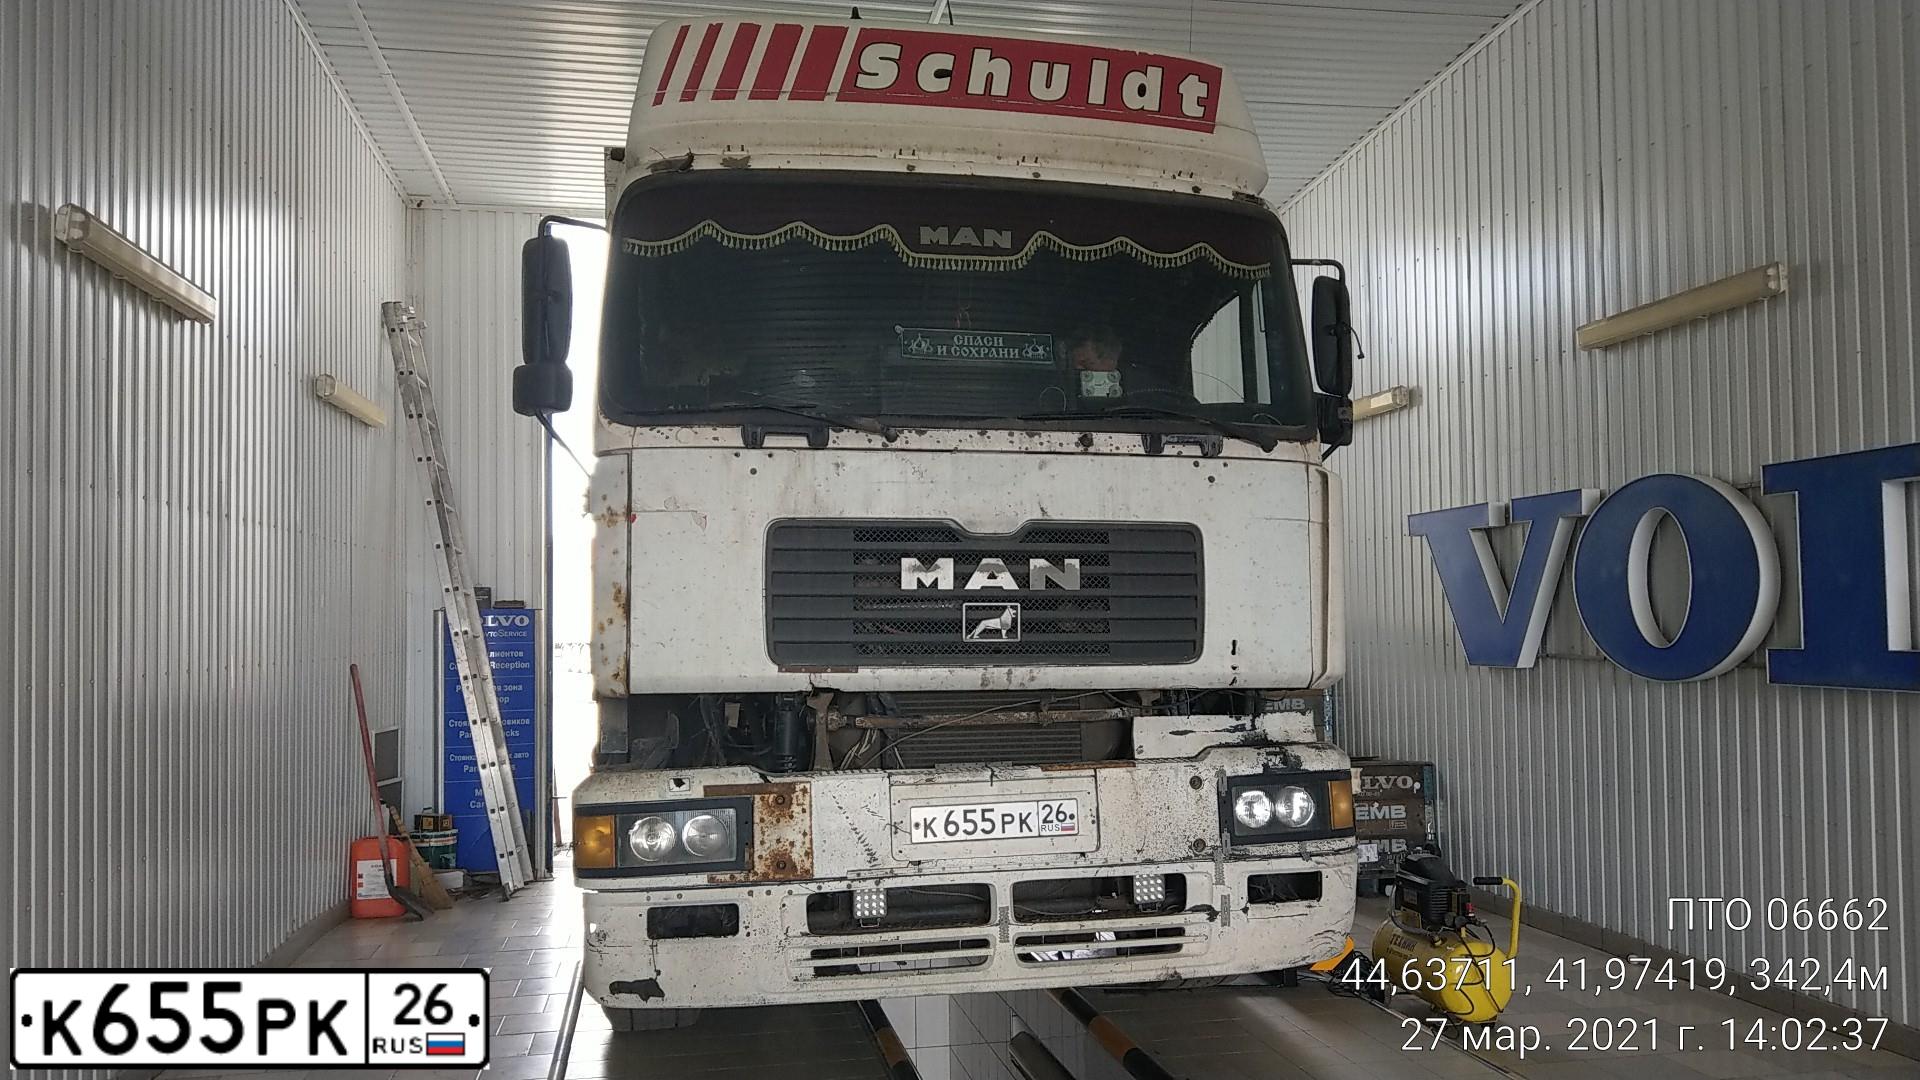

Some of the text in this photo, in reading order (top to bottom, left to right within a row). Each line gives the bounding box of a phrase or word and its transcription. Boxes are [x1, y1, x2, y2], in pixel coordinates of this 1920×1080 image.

[854, 40, 1210, 118] Schuldt
[919, 226, 1012, 249] MAN
[937, 345, 1020, 359] И СОХРАНИ
[901, 557, 1081, 590] MAN
[1041, 803, 1068, 823] 26
[1040, 824, 1061, 832] RUS
